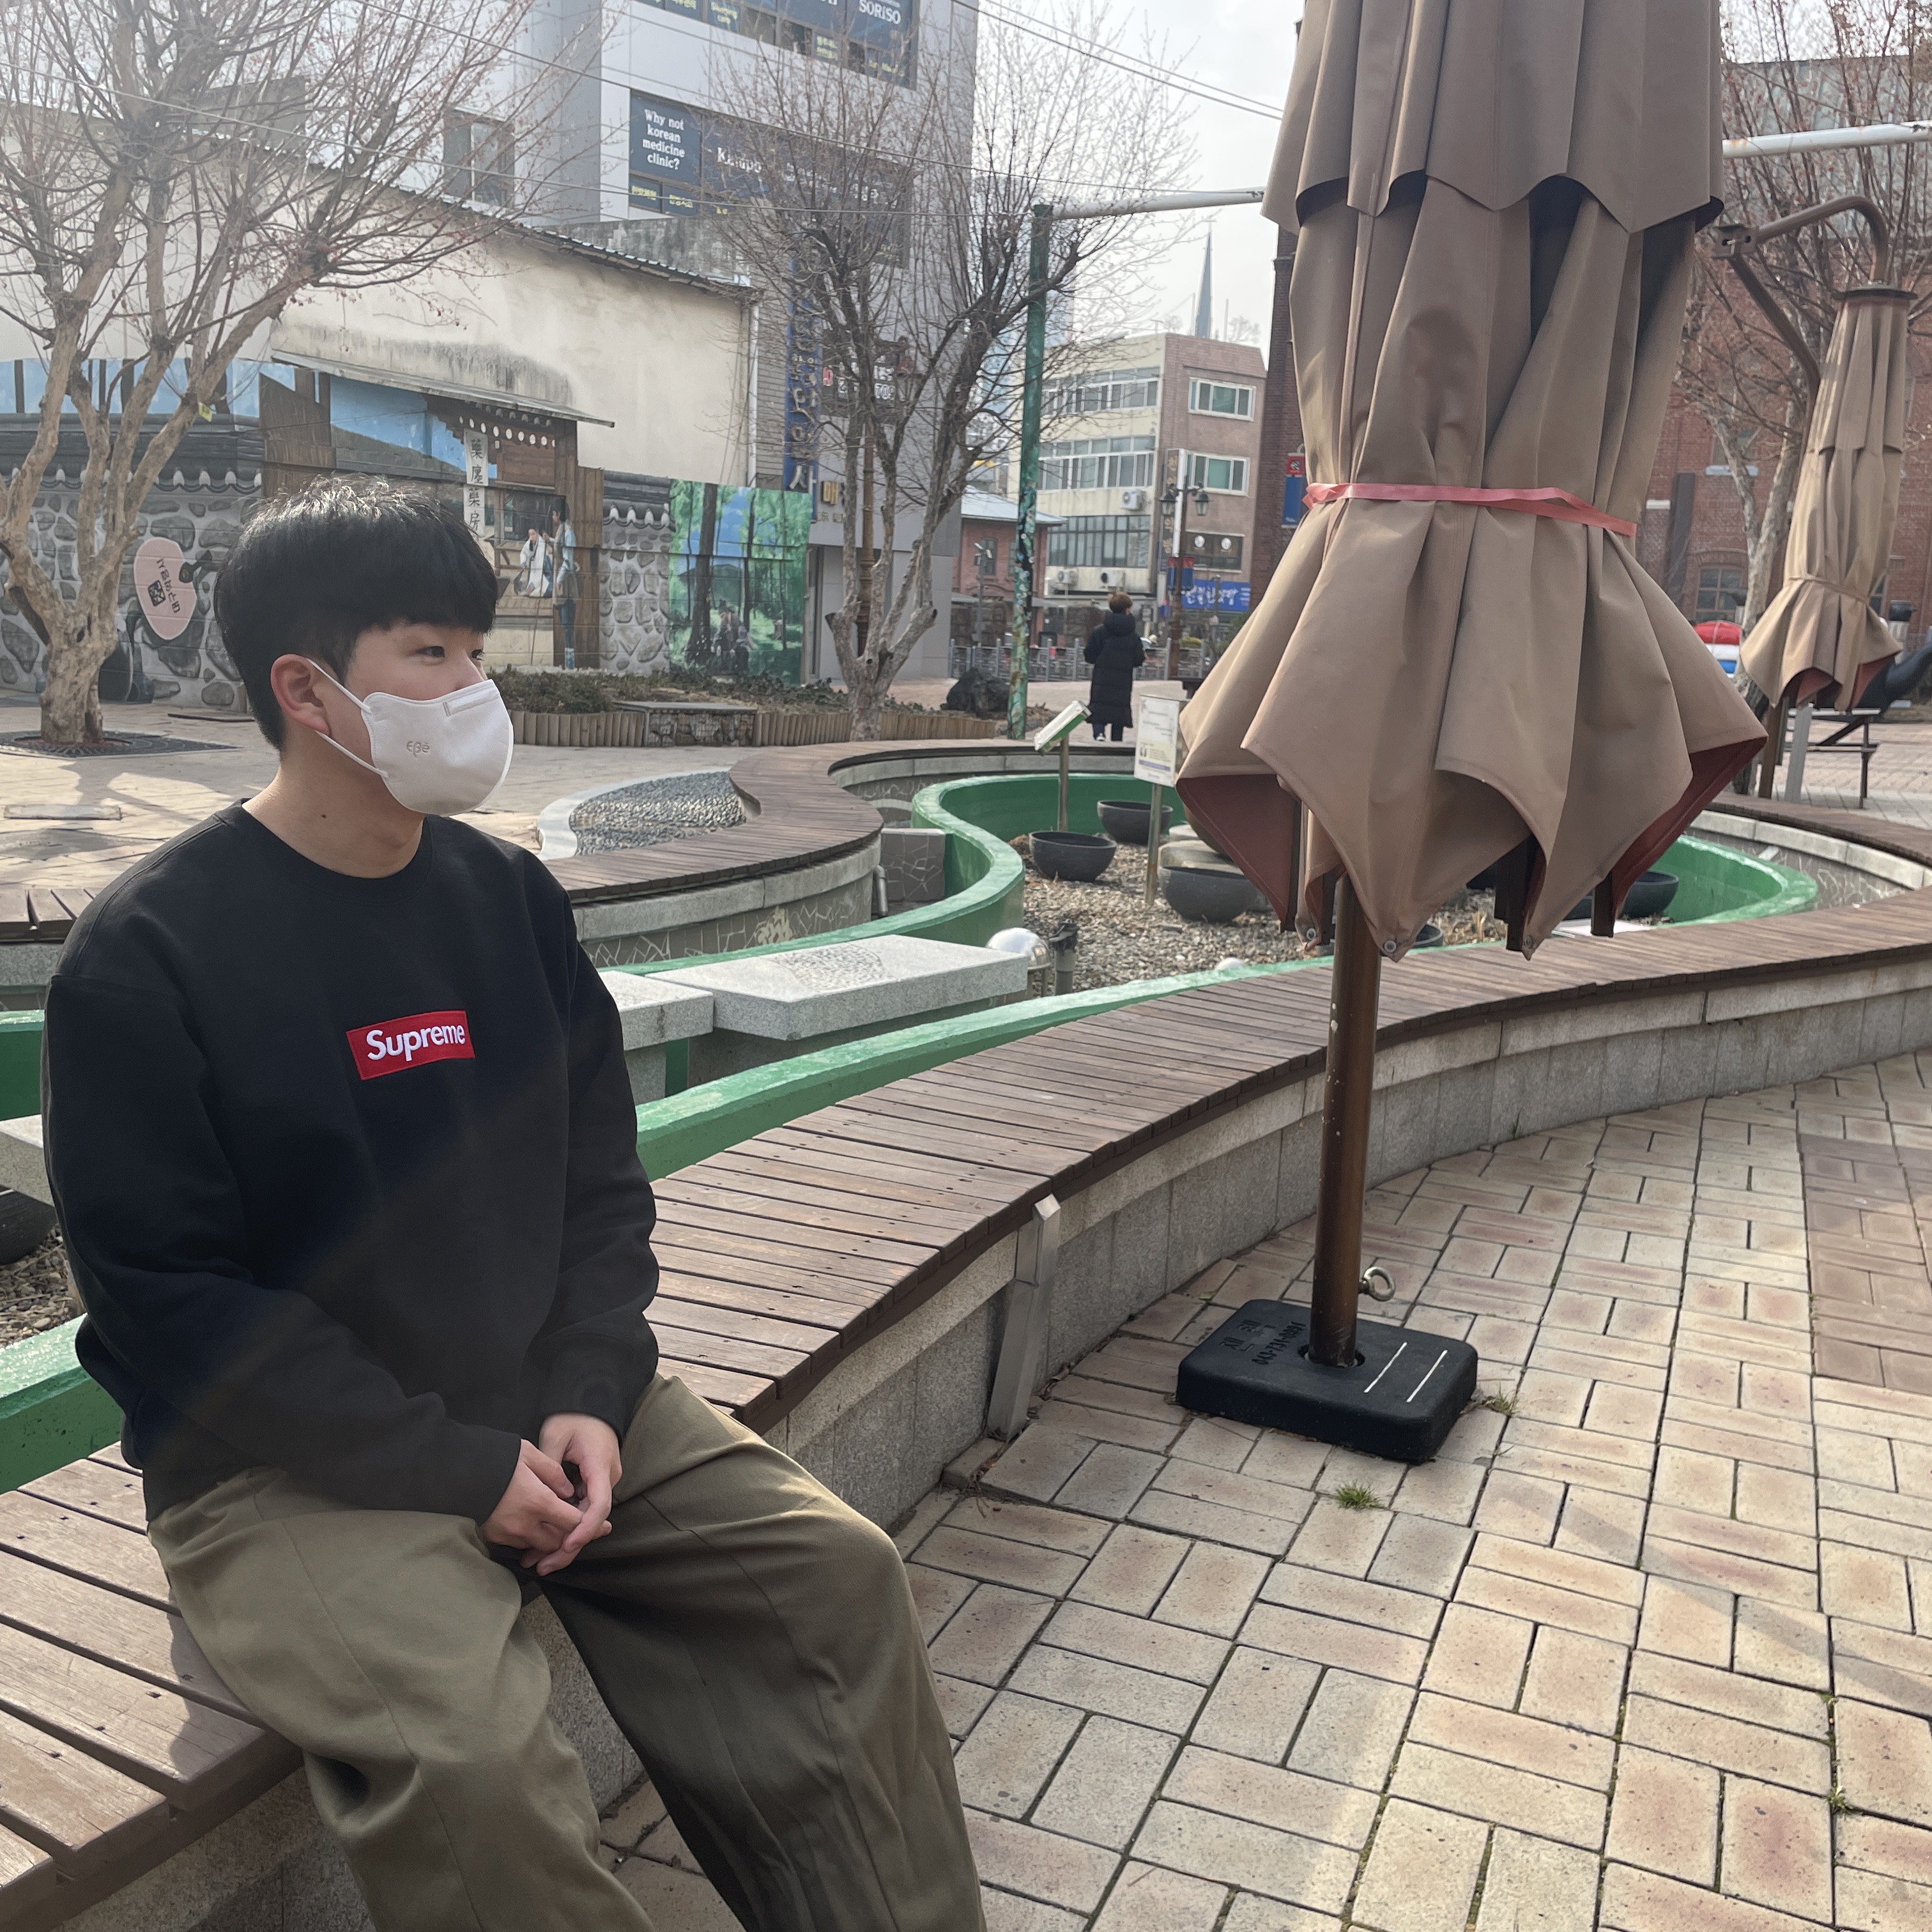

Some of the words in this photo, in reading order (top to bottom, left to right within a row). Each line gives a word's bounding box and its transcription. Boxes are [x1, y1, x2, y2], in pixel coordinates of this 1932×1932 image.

[644, 109, 666, 126] Why
[668, 117, 685, 131] not
[647, 124, 682, 143] korean
[643, 139, 686, 158] medicine
[647, 153, 680, 171] clinic?
[366, 1024, 466, 1062] Supreme
